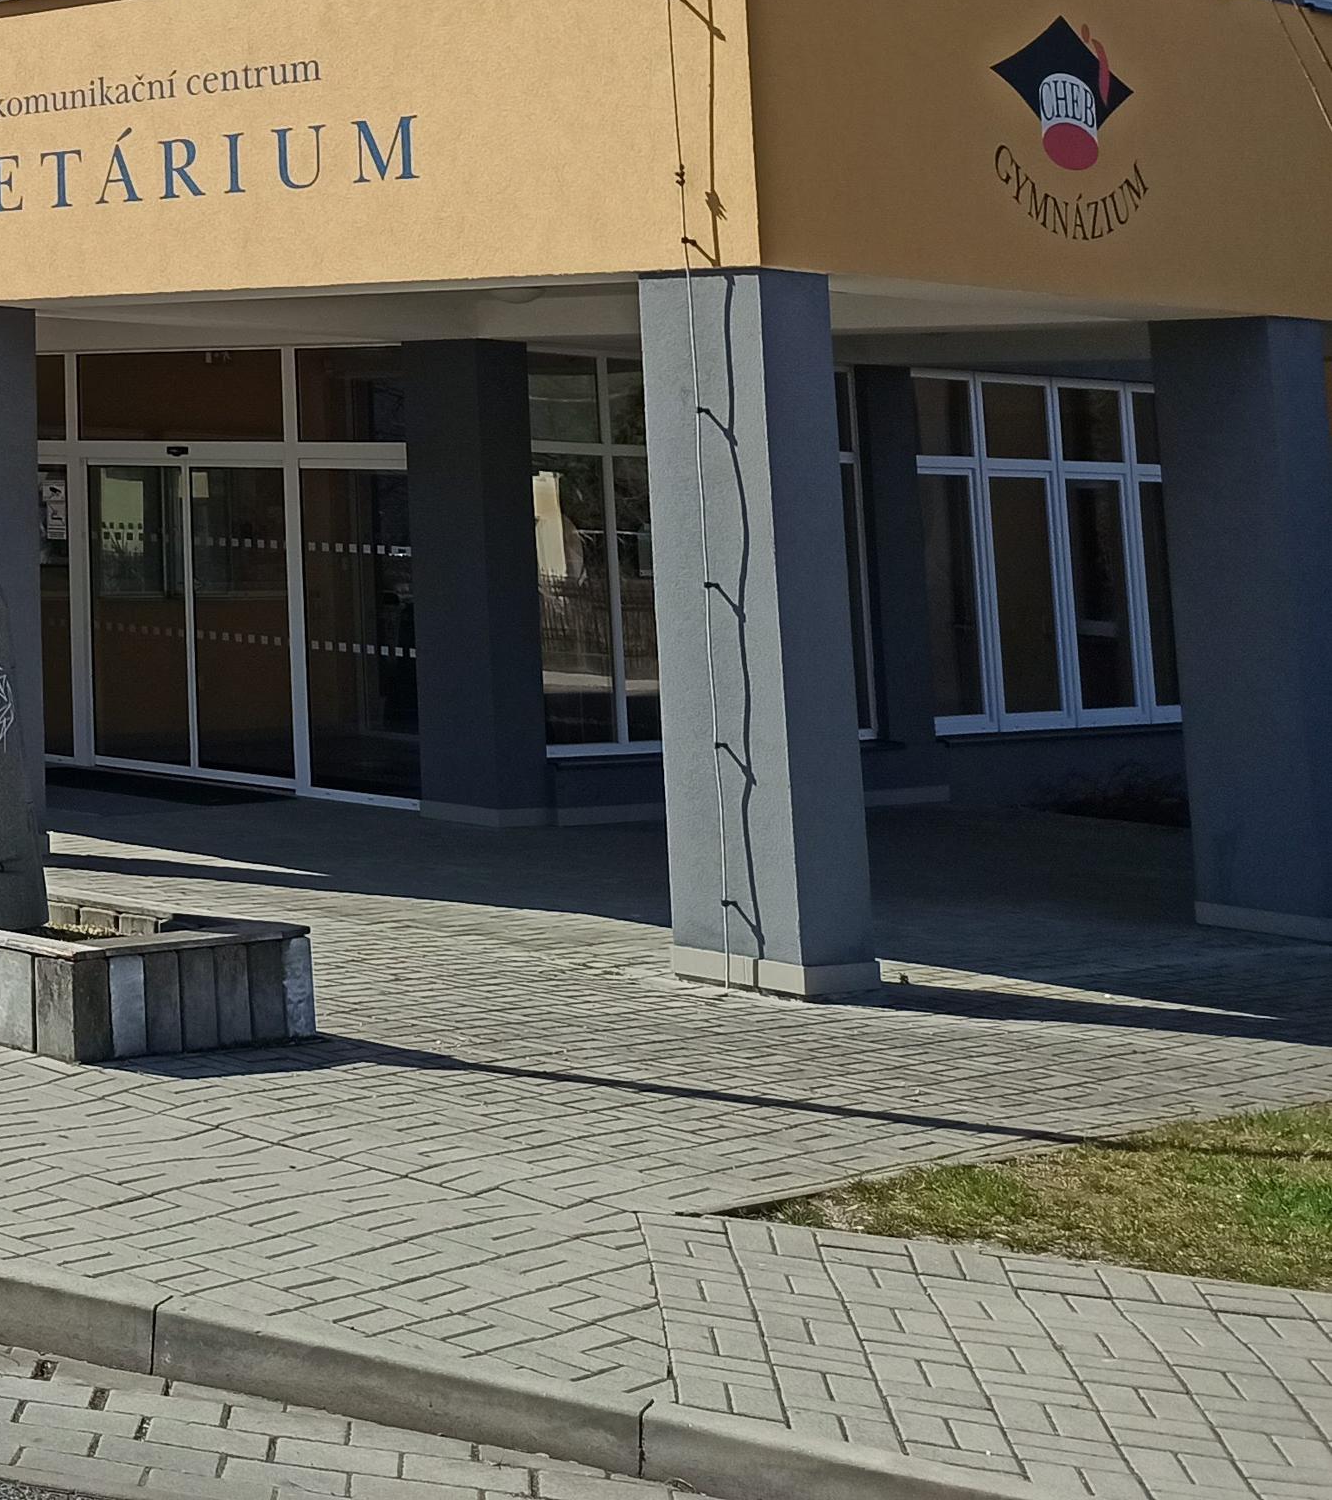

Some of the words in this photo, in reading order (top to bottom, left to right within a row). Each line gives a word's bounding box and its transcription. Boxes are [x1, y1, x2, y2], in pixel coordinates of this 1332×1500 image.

[186, 58, 322, 96] centrum
[1040, 80, 1095, 128] CHEB
[994, 144, 1149, 241] GYMNÁZIUM
